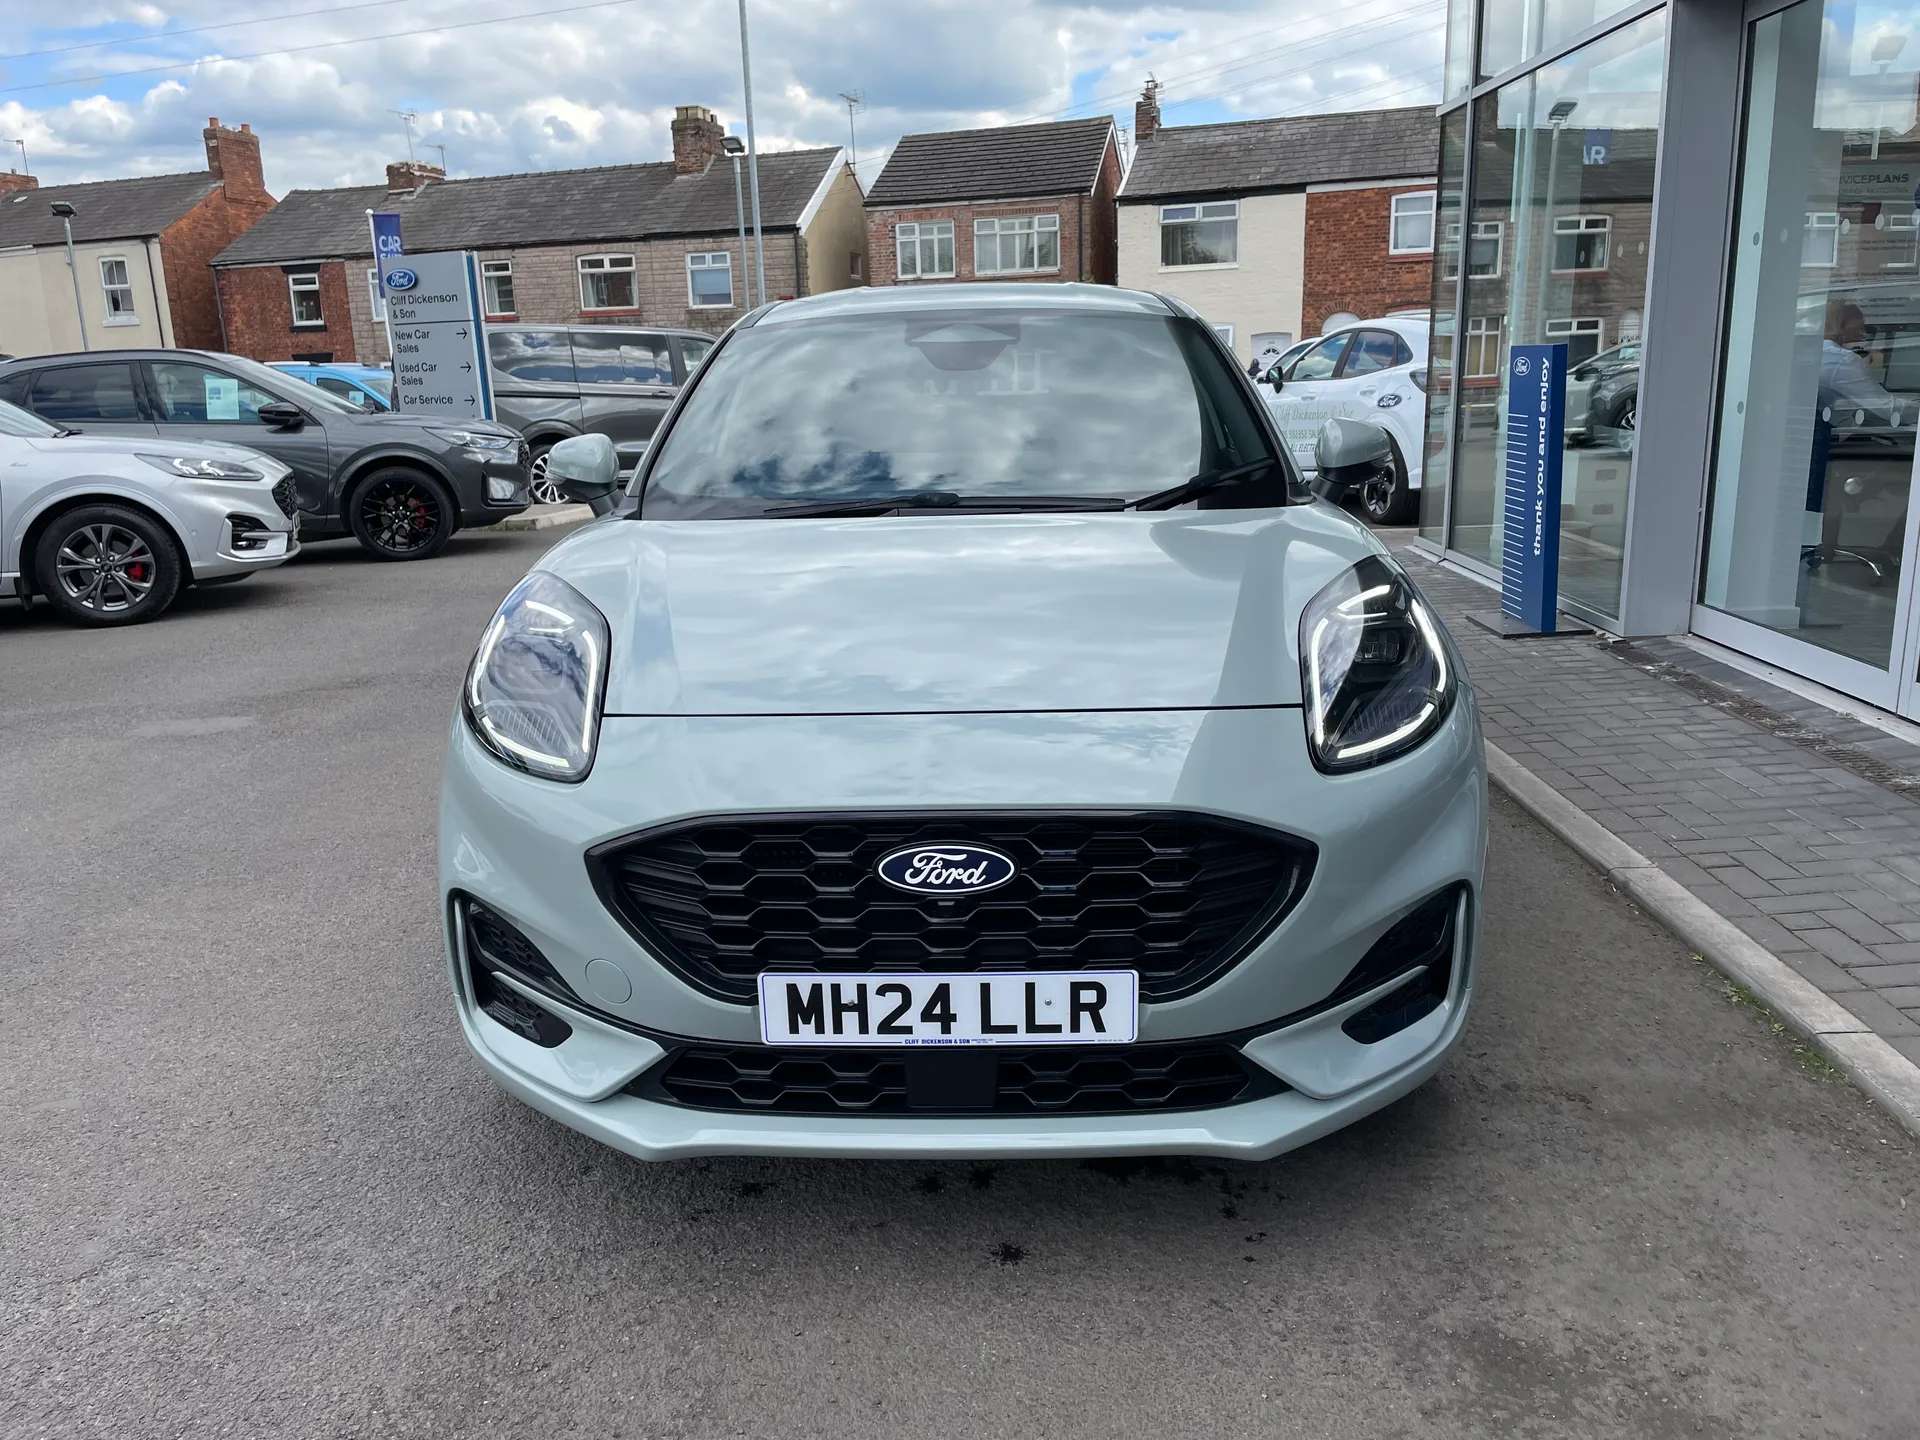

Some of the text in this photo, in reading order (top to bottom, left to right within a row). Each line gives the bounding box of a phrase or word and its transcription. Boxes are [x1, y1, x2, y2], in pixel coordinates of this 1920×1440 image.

[379, 235, 402, 252] CAR
[408, 293, 458, 304] Dickenson
[393, 308, 416, 319] & Son
[395, 329, 430, 341] New Car
[397, 343, 419, 353] Sales
[400, 362, 437, 373] Used Car
[401, 376, 424, 386] Sales
[1540, 357, 1550, 413] enjoy
[403, 394, 454, 405] Car Service
[1538, 417, 1546, 456] and
[1534, 499, 1543, 556] thank
[904, 851, 986, 885] Ford
[785, 980, 1107, 1035] MH24 LLR
